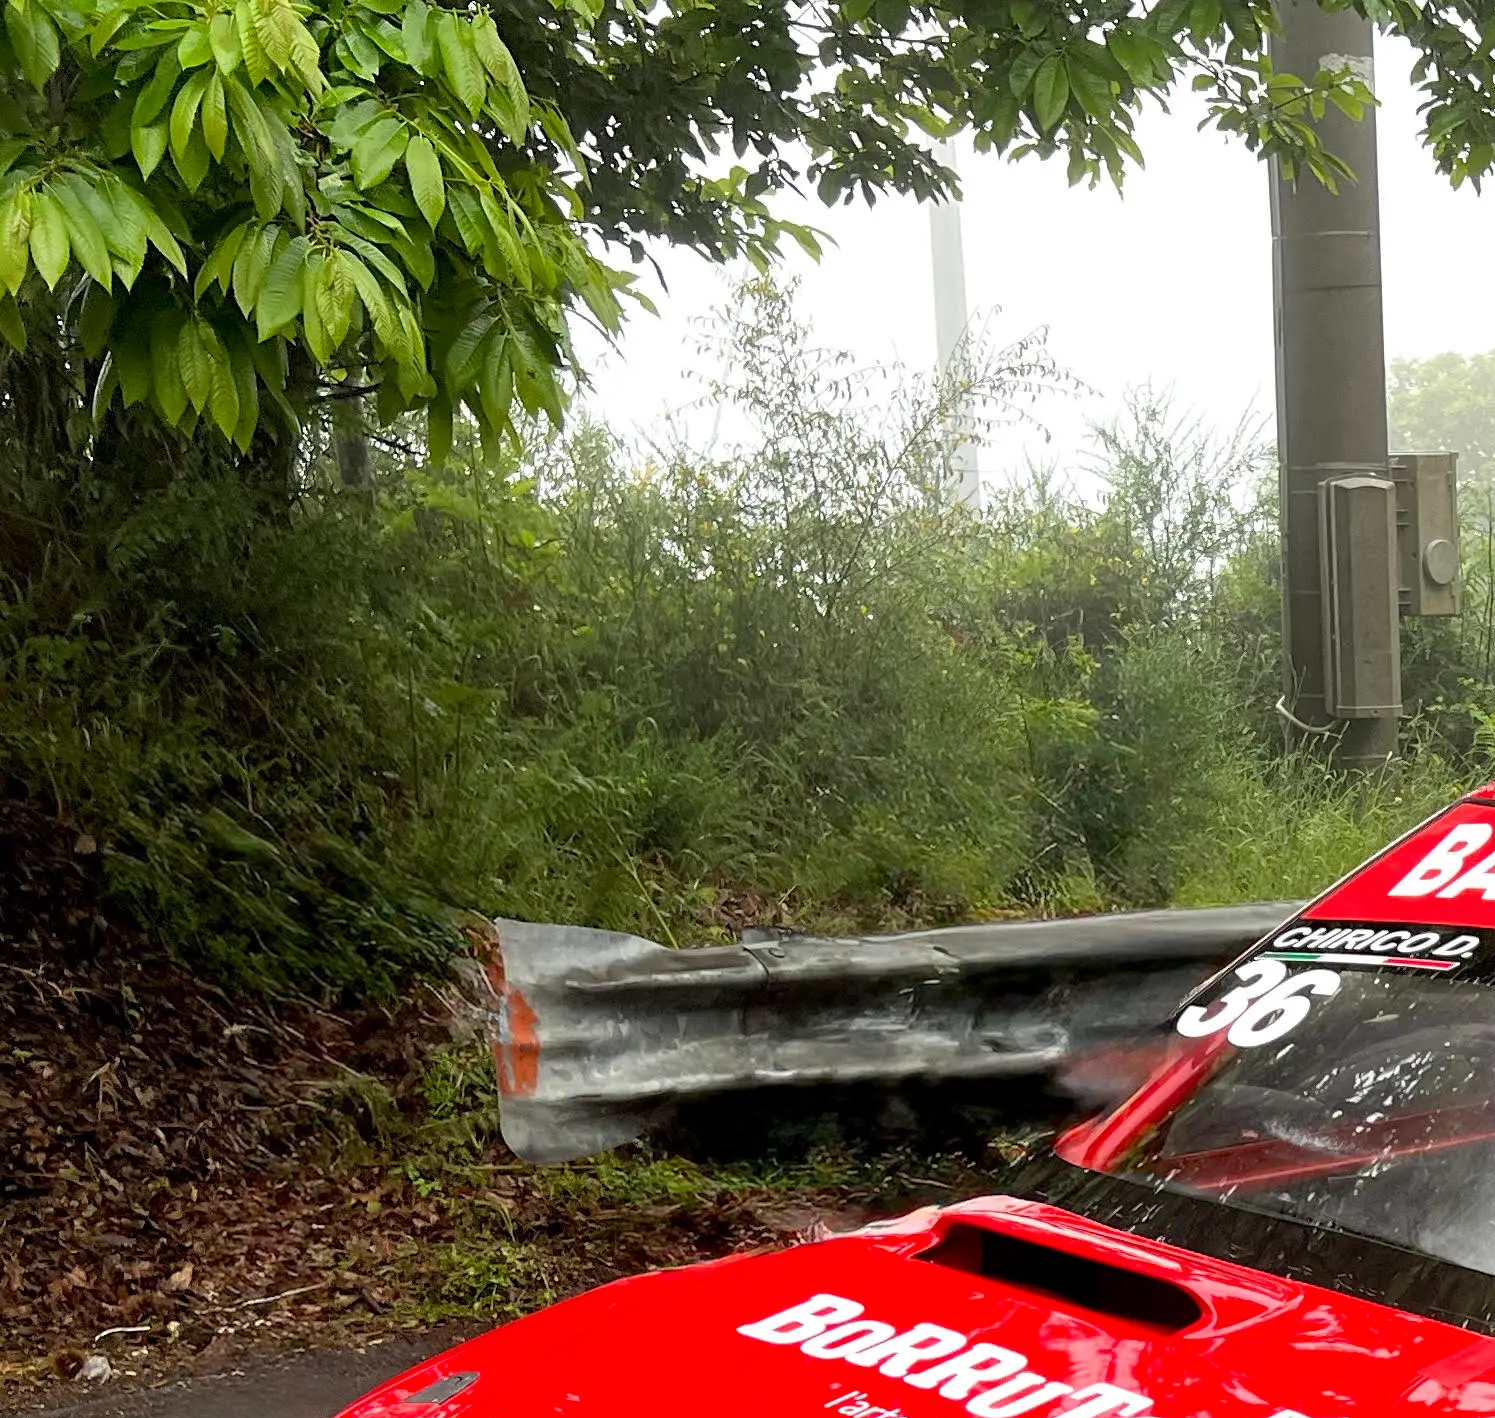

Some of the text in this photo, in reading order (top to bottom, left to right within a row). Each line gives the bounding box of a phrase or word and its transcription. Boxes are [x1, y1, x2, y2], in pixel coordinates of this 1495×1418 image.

[1273, 927, 1480, 958] CHIRICO D.
[1176, 959, 1342, 1048] 36
